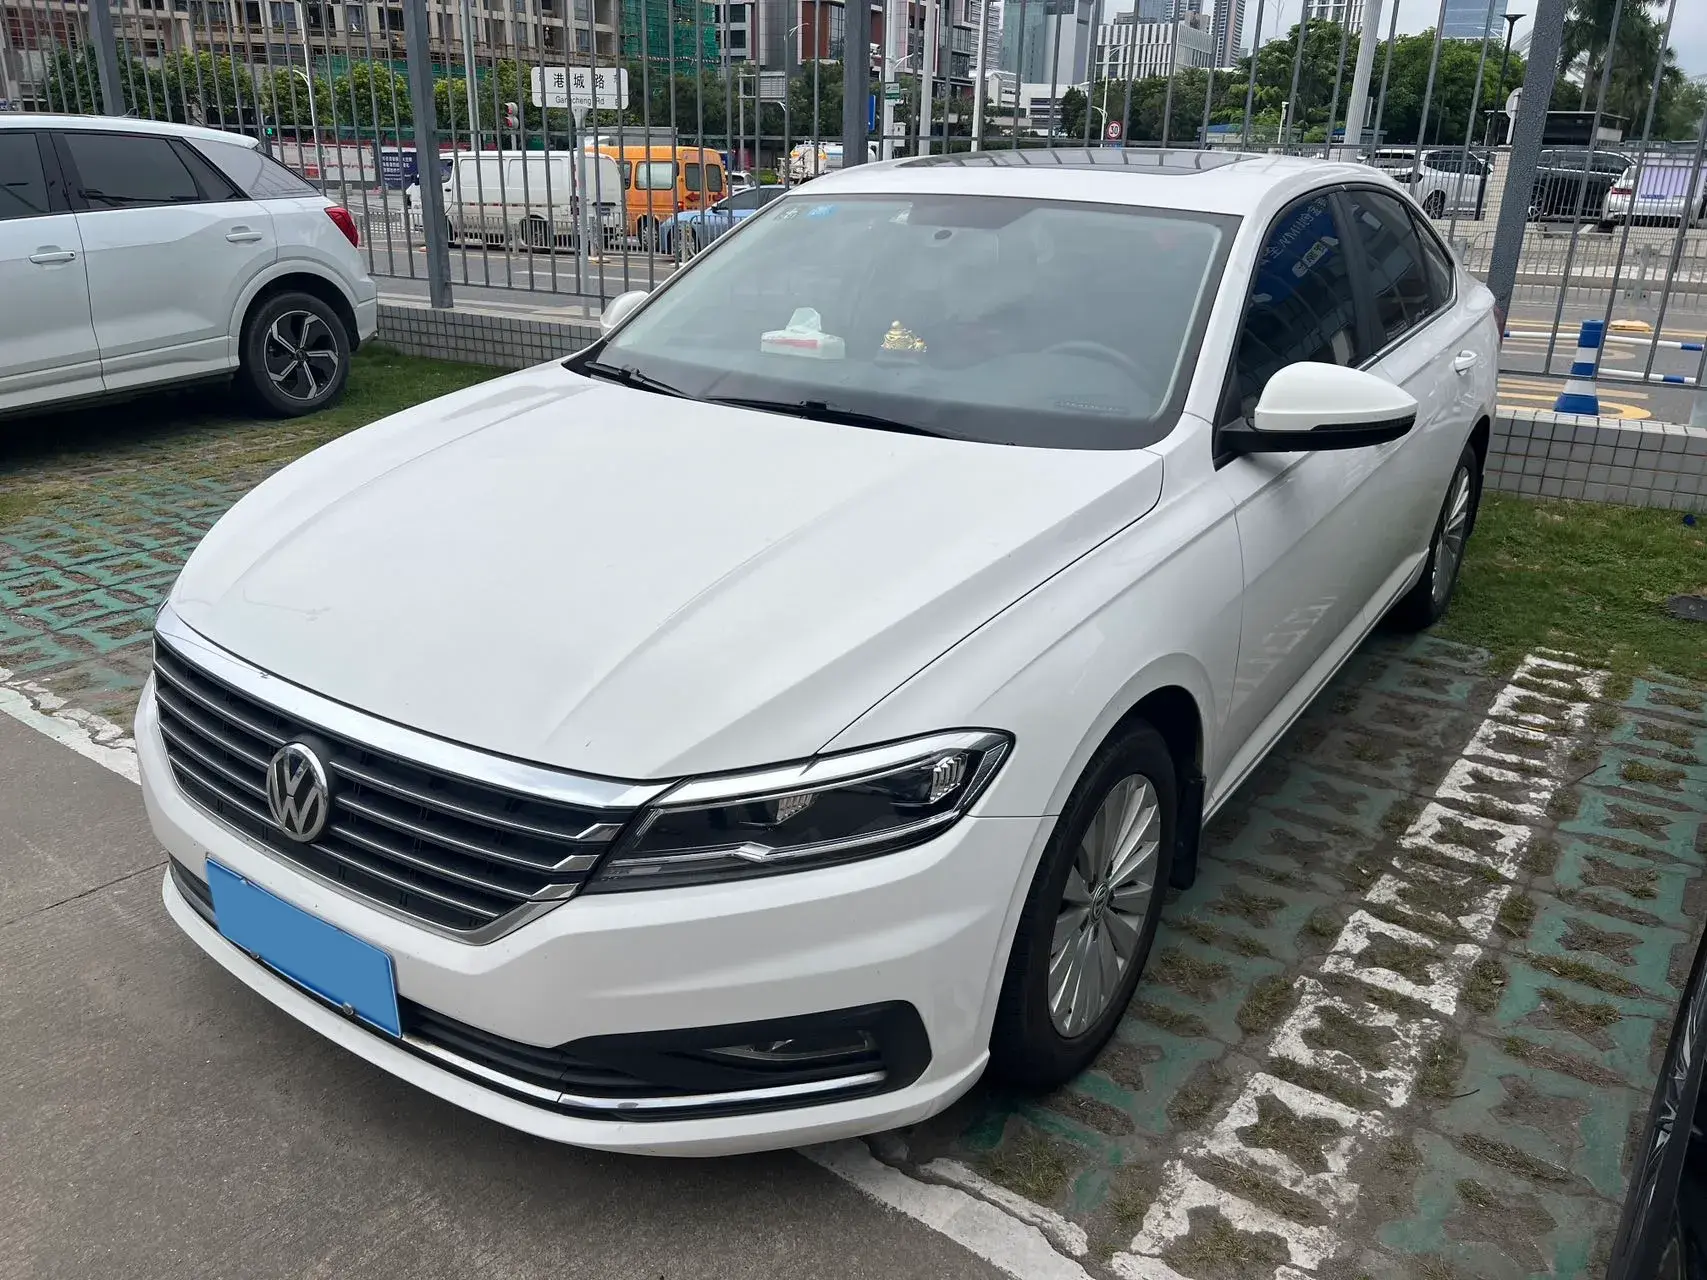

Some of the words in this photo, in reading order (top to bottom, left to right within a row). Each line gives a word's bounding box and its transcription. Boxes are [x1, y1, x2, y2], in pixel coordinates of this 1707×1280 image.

[553, 73, 605, 89] 港城路
[555, 95, 591, 106] Gancheng
